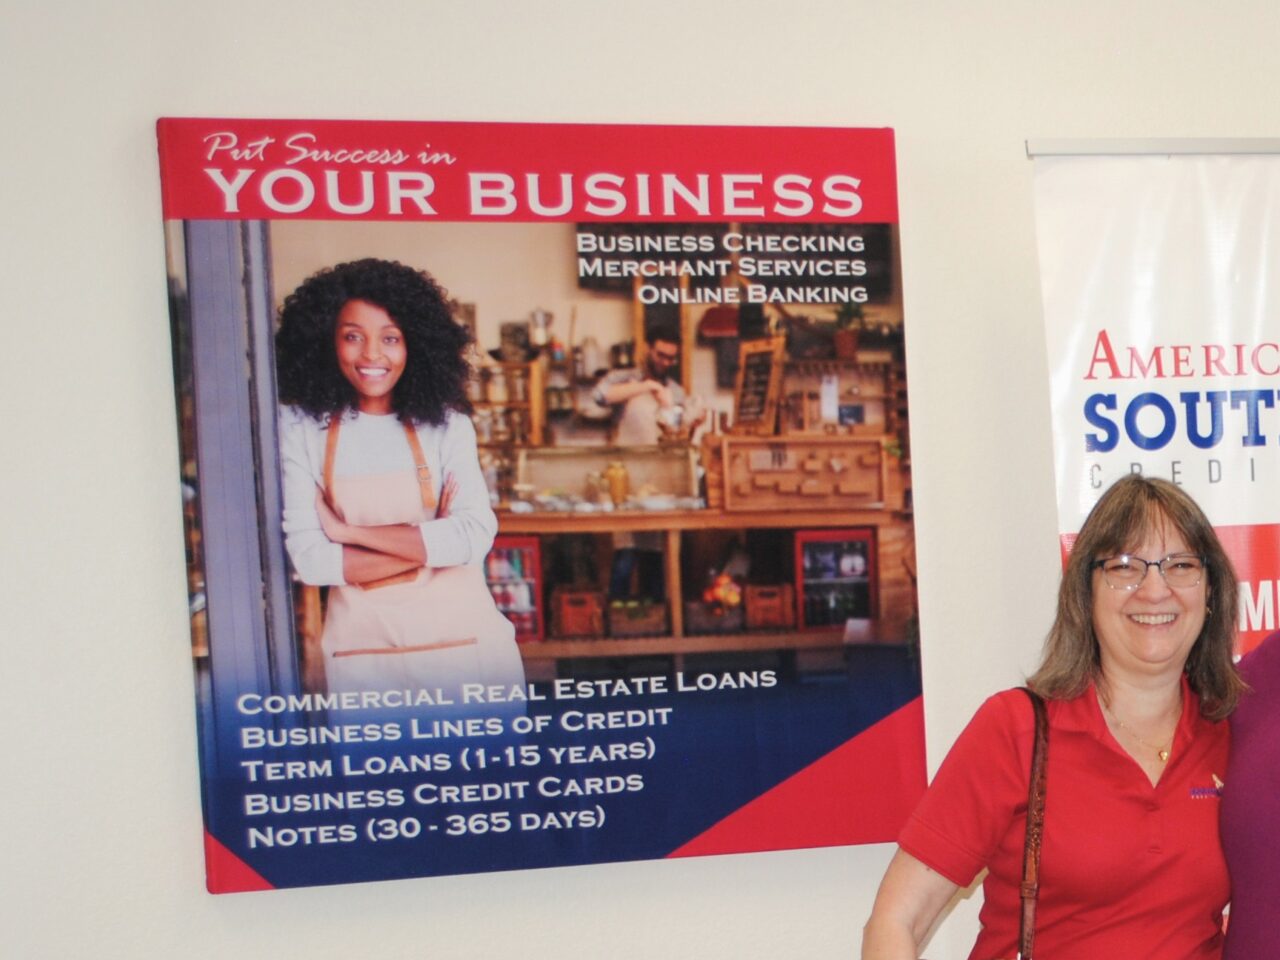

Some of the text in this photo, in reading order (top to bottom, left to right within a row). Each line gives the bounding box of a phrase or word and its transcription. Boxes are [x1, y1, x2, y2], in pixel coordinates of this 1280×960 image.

[203, 132, 457, 166] Put Success in
[204, 168, 864, 218] YOUR BUSINESS
[576, 232, 866, 253] BUSINESS CHECKING
[578, 257, 867, 277] MERCHANT SERVICES
[637, 284, 868, 305] ONLINE BANKING
[237, 671, 778, 716] COMMERCIAL REAL ESTATE LOANS
[241, 708, 673, 749] BUSINESS LINES OF CREDIT
[240, 737, 656, 782] TERM LOANS (1-15 YEARS)
[244, 774, 644, 816] BUSINESS CREDIT CARDS
[248, 824, 358, 849] NOTES
[366, 817, 421, 843] (30
[446, 812, 513, 837] 365
[520, 805, 606, 831] DAYS)
